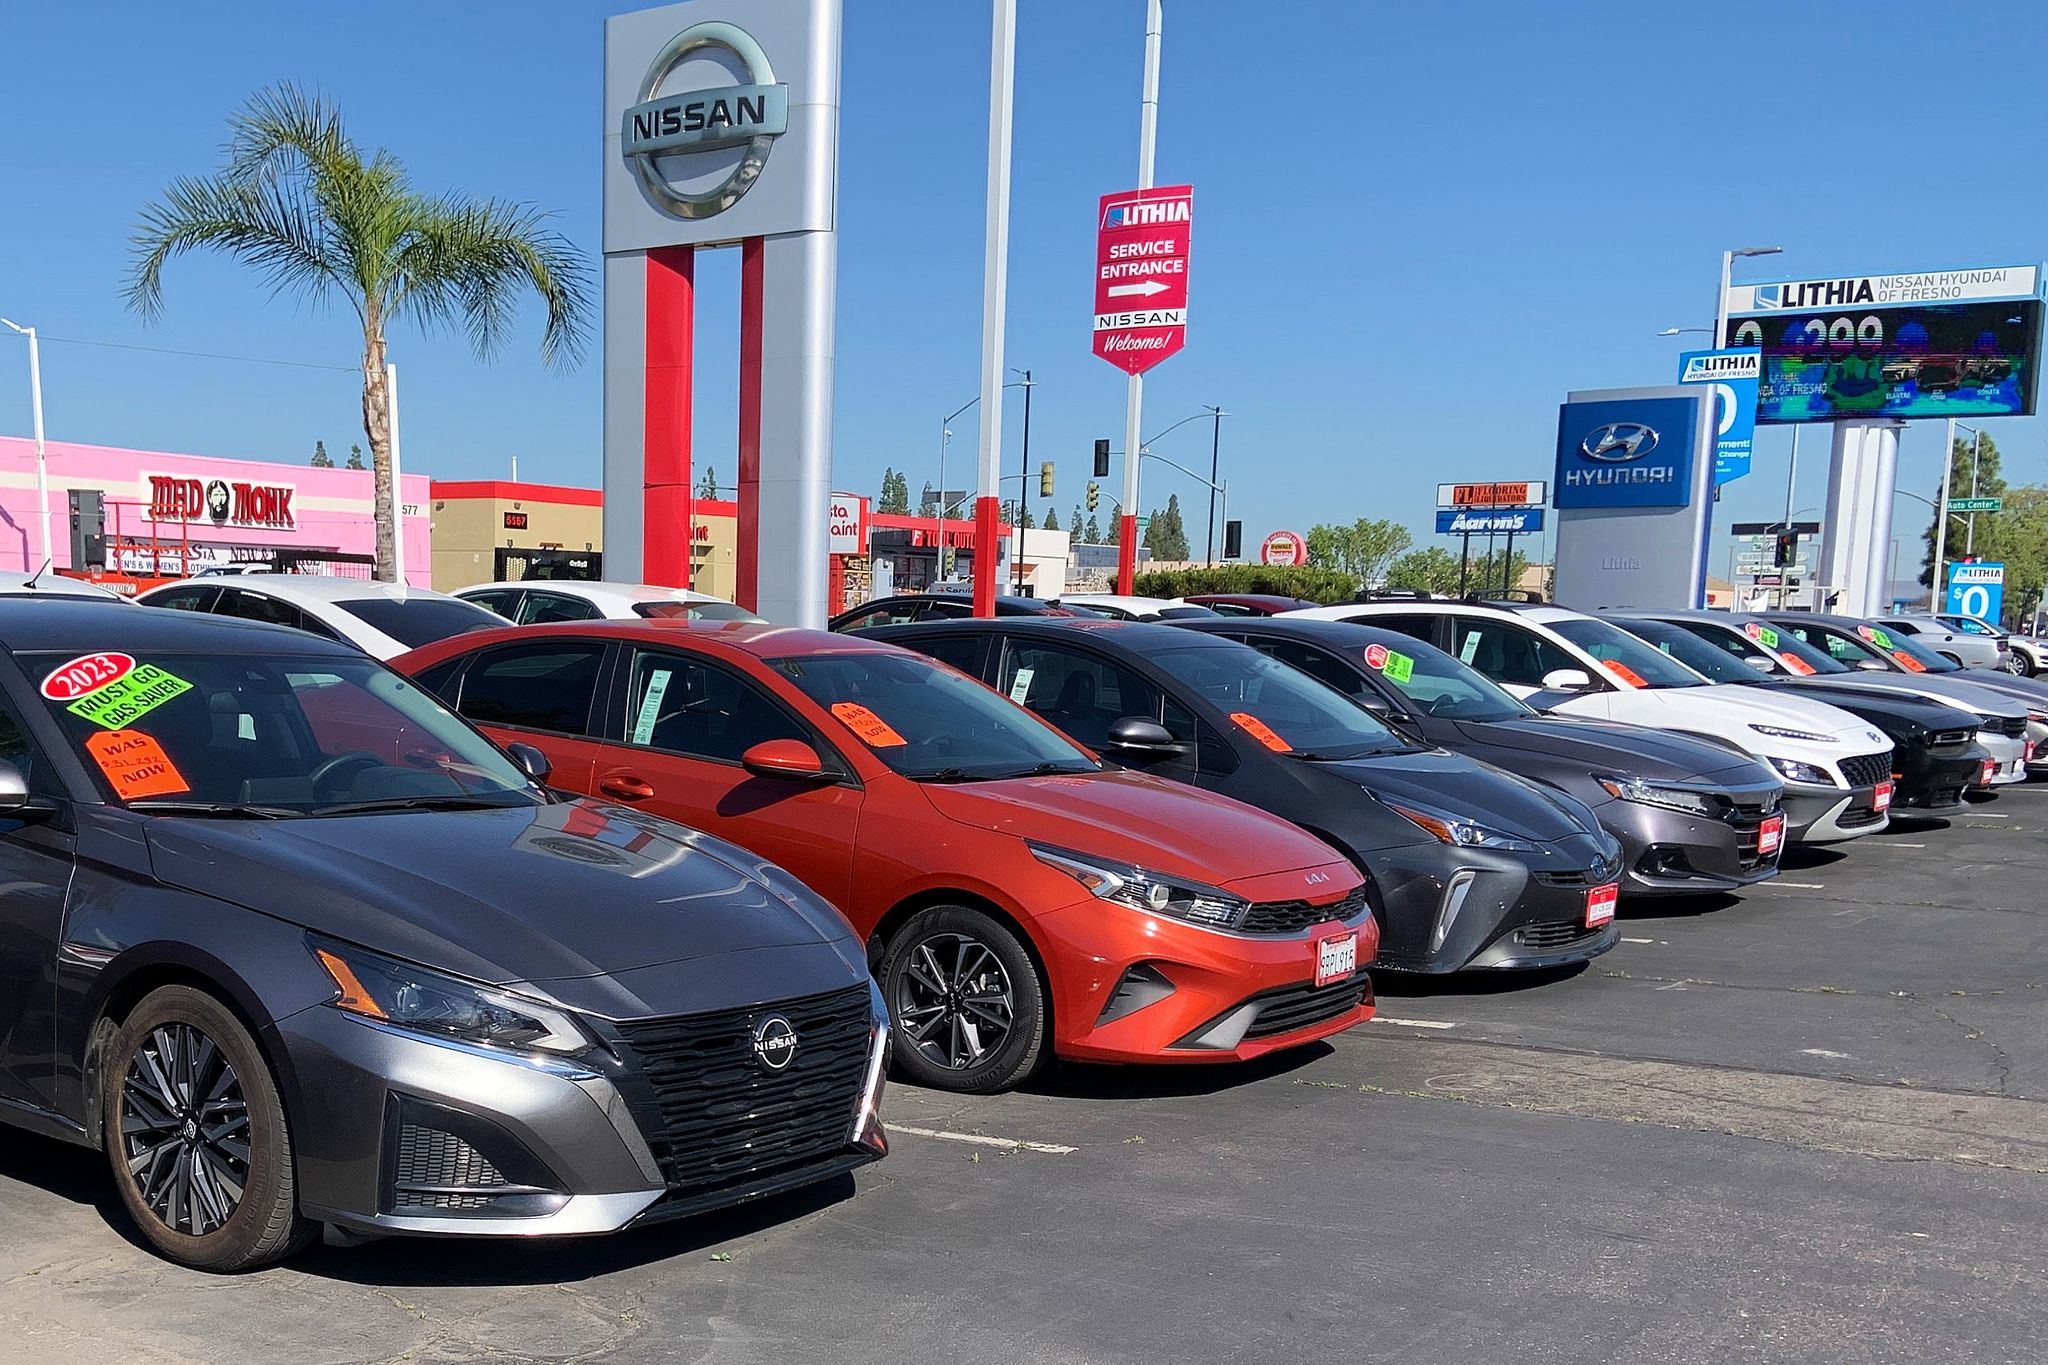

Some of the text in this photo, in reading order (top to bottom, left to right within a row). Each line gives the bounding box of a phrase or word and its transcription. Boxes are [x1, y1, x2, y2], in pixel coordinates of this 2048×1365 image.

[633, 95, 765, 142] NISSAN
[1122, 201, 1190, 226] LITHIA
[1110, 240, 1175, 259] SERVICE
[1101, 260, 1183, 279] ENTRANCE
[1878, 270, 2007, 289] NISSAN HYUNDAI
[1781, 279, 1875, 307] LITHIA
[1878, 286, 1961, 302] OF FRESNO
[1100, 311, 1179, 329] NISSAN
[1104, 331, 1173, 352] Welcome!
[1705, 356, 1757, 371] LITHIA
[1687, 372, 1717, 380] HYUNDAI
[1718, 450, 1750, 459] Change
[1565, 466, 1674, 486] HYUNDAI
[148, 476, 294, 527] MAD MONK
[1476, 494, 1526, 503] LIQUDATORS
[1947, 501, 1965, 509] Auto
[1967, 500, 1993, 509] Center
[831, 520, 857, 536] aint
[1450, 514, 1524, 530] Aaron's
[954, 532, 975, 549] OUTL
[230, 546, 259, 560] NEW
[1601, 556, 1641, 571] Lithia
[1969, 569, 2001, 578] LITHIA
[56, 656, 119, 696] 2023
[76, 668, 161, 715] MUST GO
[102, 738, 147, 755] WAS
[122, 763, 166, 784] NOW
[754, 1035, 797, 1052] NISSAN
